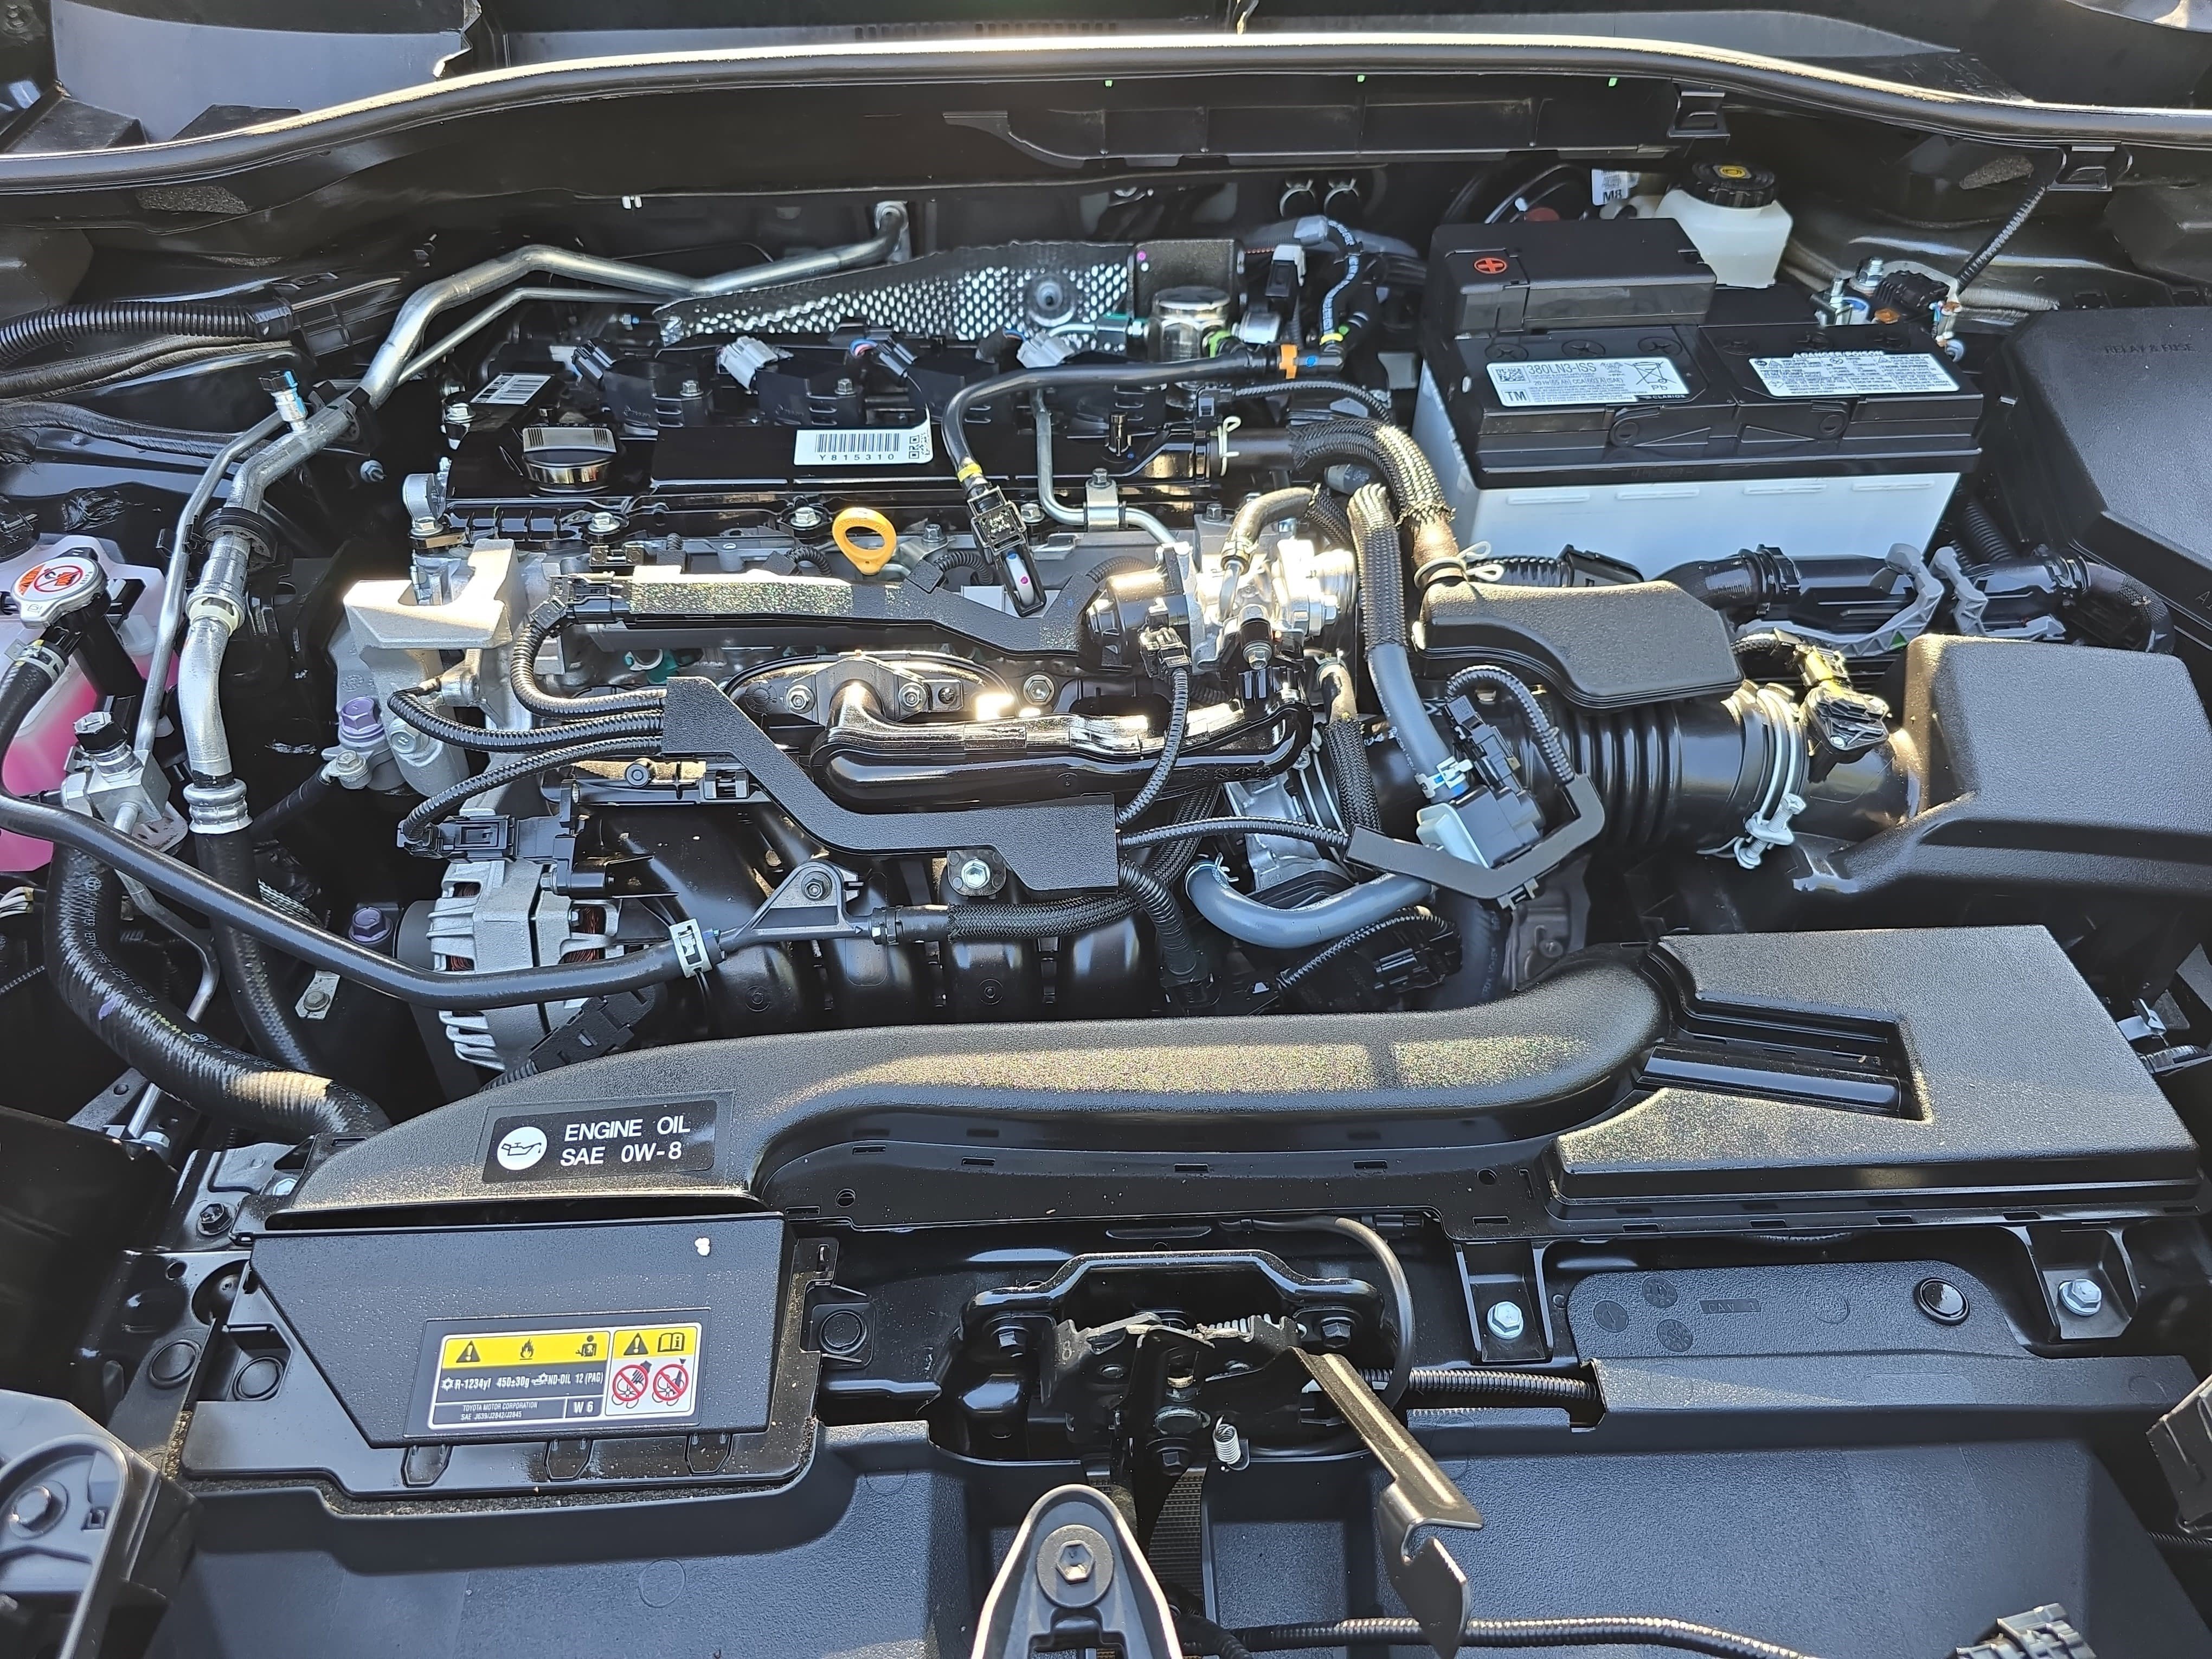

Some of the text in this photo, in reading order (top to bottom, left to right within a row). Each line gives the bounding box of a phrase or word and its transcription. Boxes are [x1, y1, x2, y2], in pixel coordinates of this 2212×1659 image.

[1527, 362, 1597, 375] 380LN3-ISS
[1504, 391, 1527, 401] TM
[564, 1115, 691, 1142] ENGINE OIL
[560, 1141, 682, 1166] SAE 0W-8
[454, 1378, 492, 1391] R-1234yf
[548, 1373, 571, 1385] ND-OIL
[575, 1373, 584, 1384] 12
[585, 1372, 604, 1385] (PAG)
[502, 1401, 538, 1410] CORPORATION
[573, 1400, 594, 1413] W 6
[474, 1411, 522, 1420] J639/J2842/J2845
